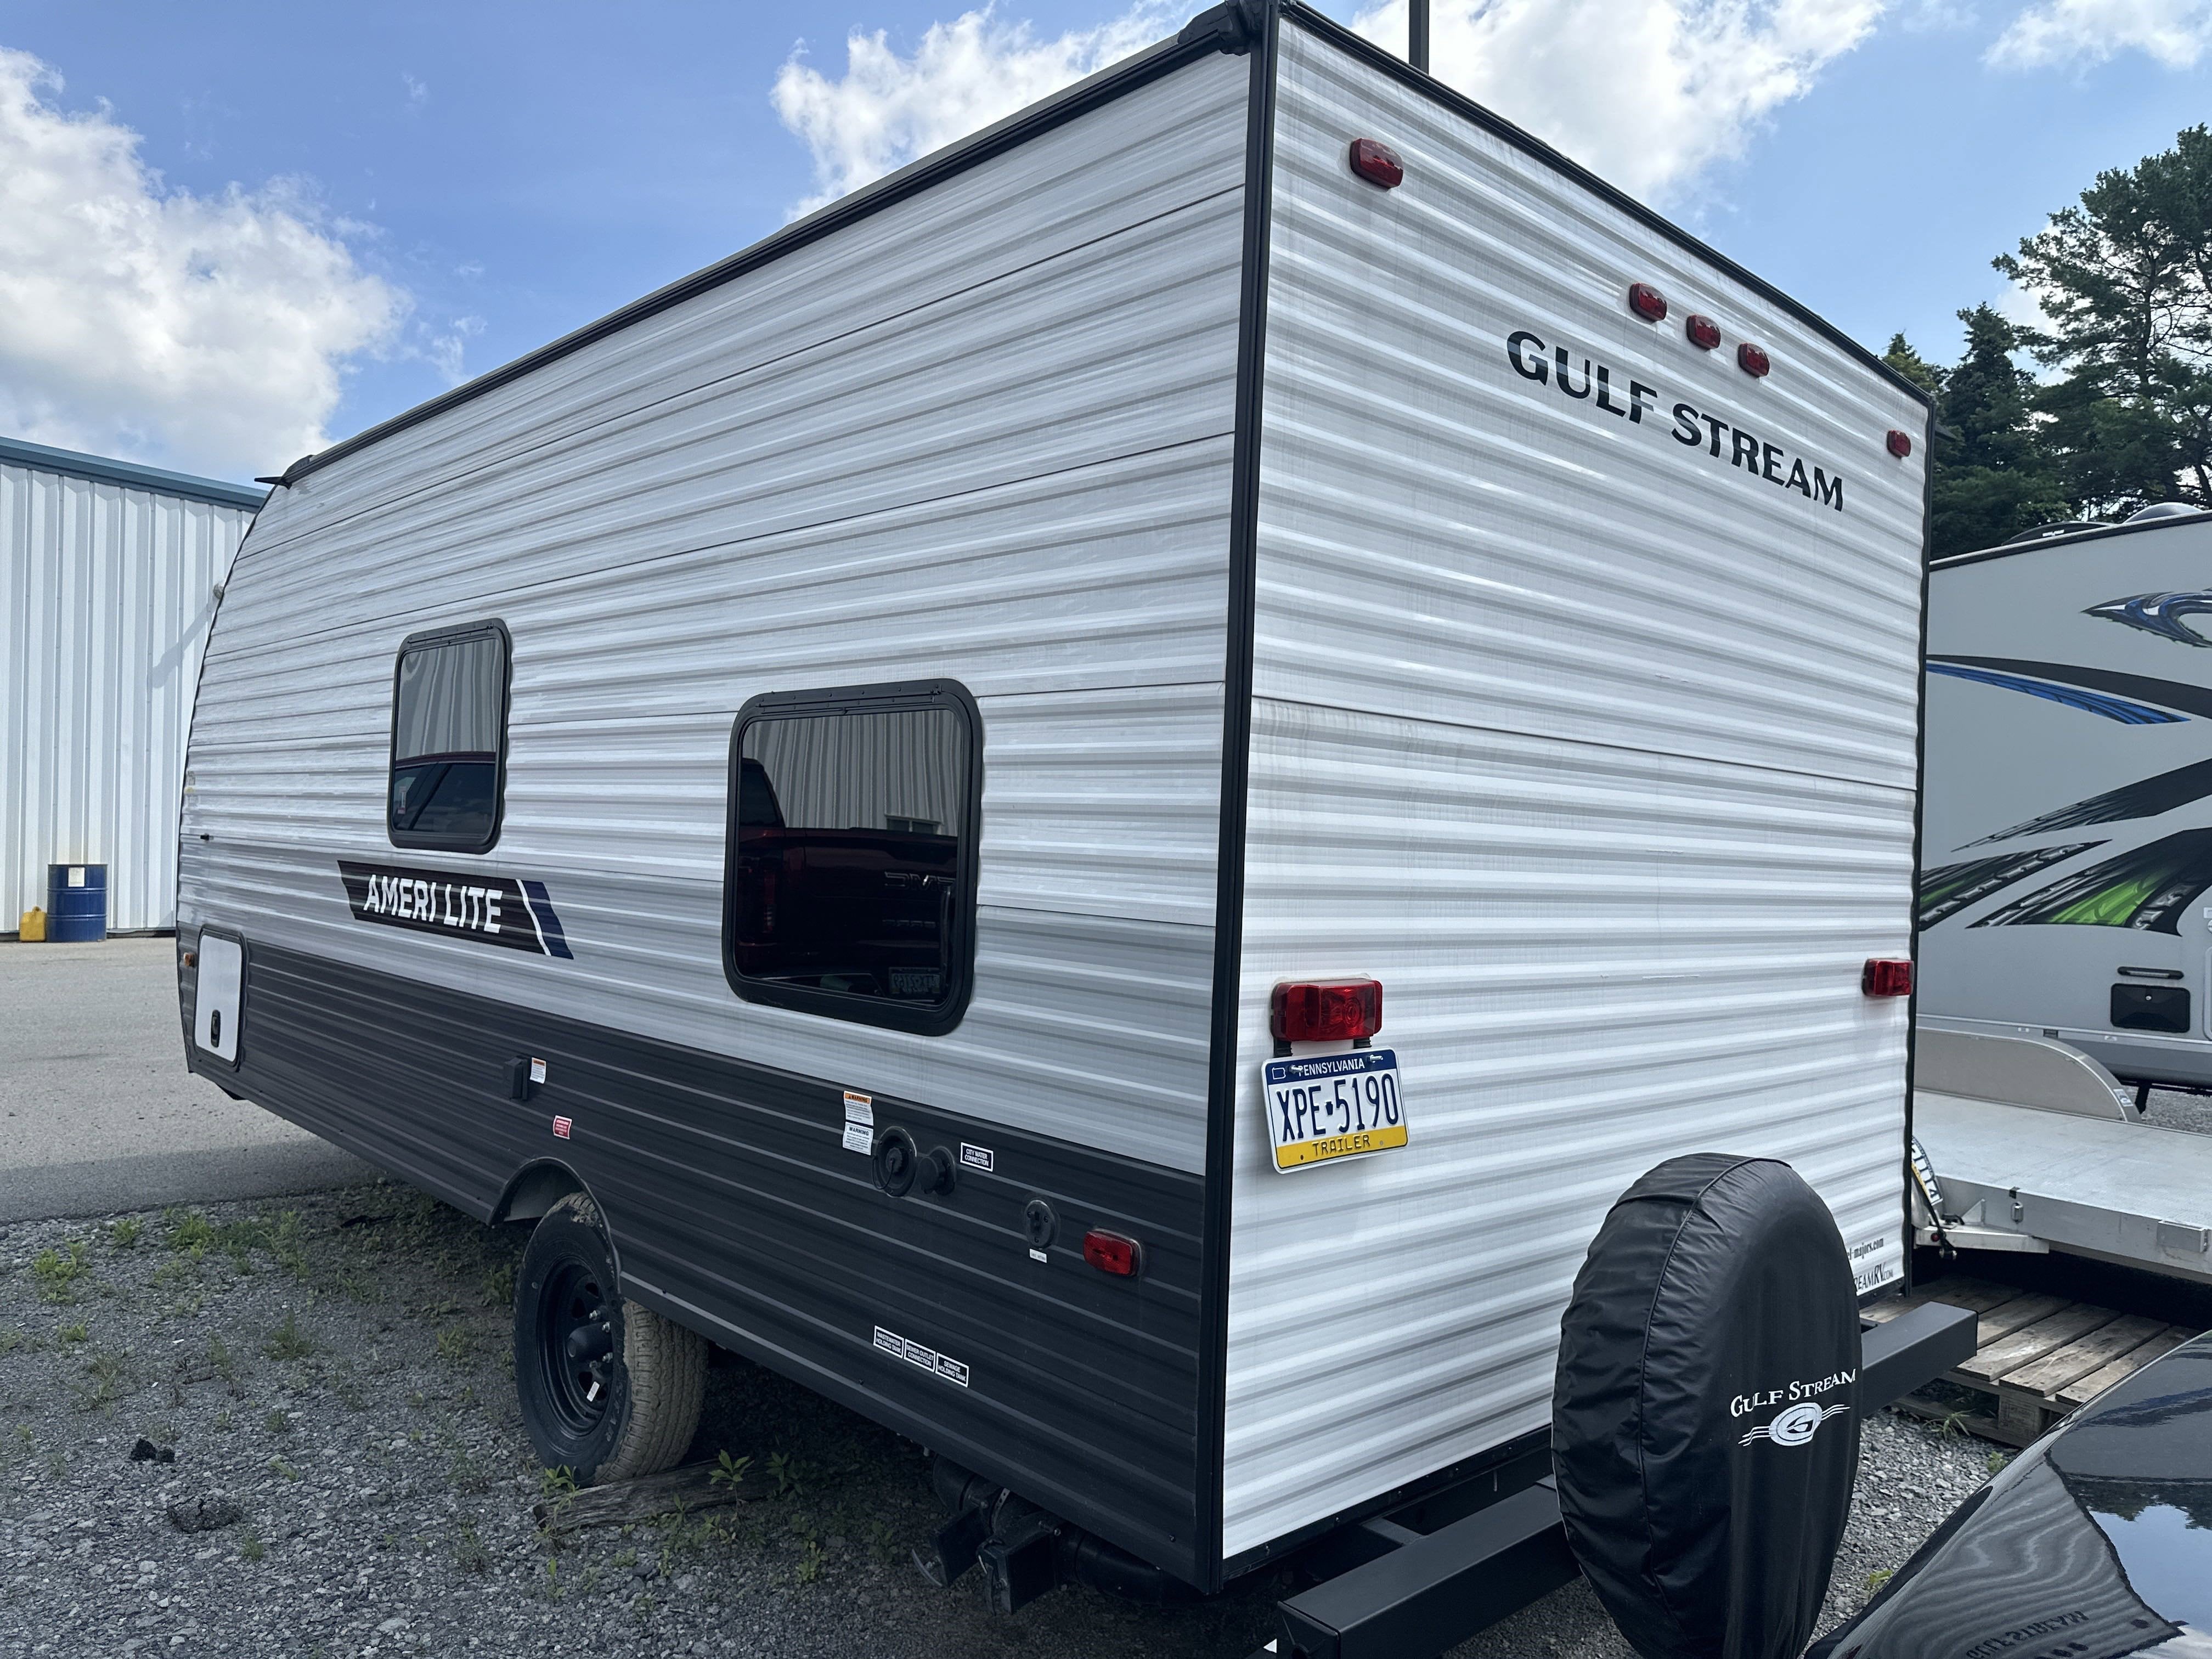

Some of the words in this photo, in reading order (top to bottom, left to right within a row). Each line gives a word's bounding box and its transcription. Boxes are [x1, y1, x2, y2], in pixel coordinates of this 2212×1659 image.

[1506, 331, 1657, 424] GULF
[1671, 403, 1842, 511] STREAM
[363, 874, 437, 922] AMERI
[443, 884, 503, 933] LITE
[1299, 1058, 1365, 1076] PENNSYLVANIA
[849, 1126, 869, 1136] WARNING
[1312, 1134, 1370, 1156] TRAILER
[964, 1154, 989, 1166] CONNECTION
[876, 1338, 891, 1349] HOLDING
[891, 1345, 901, 1353] TANK
[907, 1351, 931, 1366] CONNECTION
[919, 1350, 933, 1361] OUTLET
[938, 1364, 955, 1377] HOLDING
[955, 1372, 966, 1381] TANK
[944, 1361, 960, 1373] SEWAGE
[1730, 1390, 1783, 1417] GULF
[1788, 1369, 1856, 1401] STREAM
